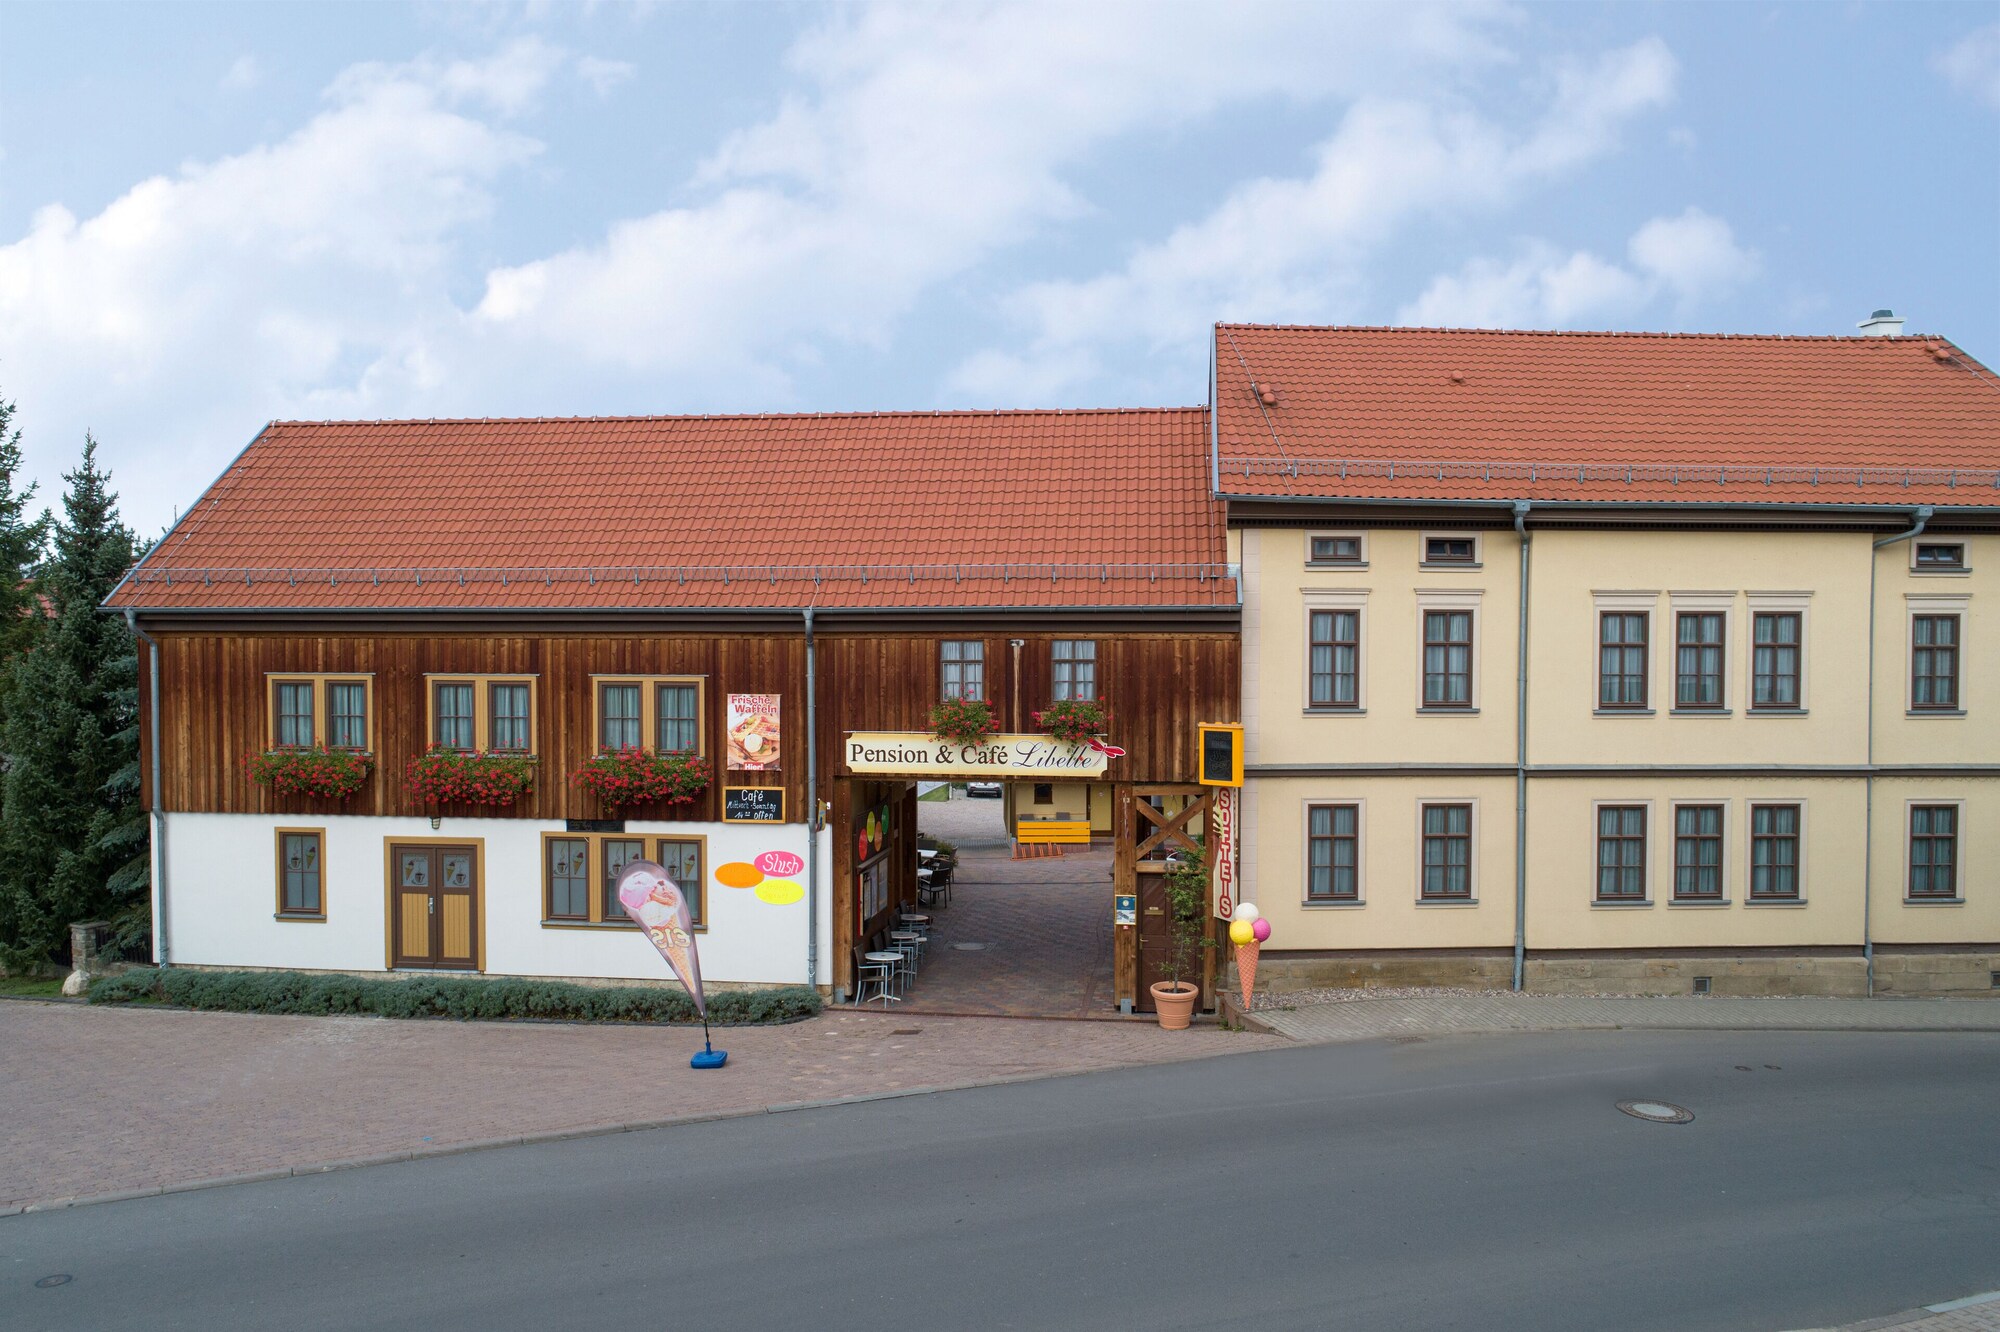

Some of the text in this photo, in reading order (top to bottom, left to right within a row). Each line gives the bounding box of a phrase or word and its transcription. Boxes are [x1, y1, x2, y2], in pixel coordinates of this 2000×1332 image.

[731, 695, 771, 704] Frische
[735, 704, 777, 713] Waffeln
[850, 740, 1092, 769] Pension & Café Libelle
[741, 790, 764, 803] Café
[1219, 787, 1233, 919] SOFTEIS
[762, 853, 800, 875] Slush
